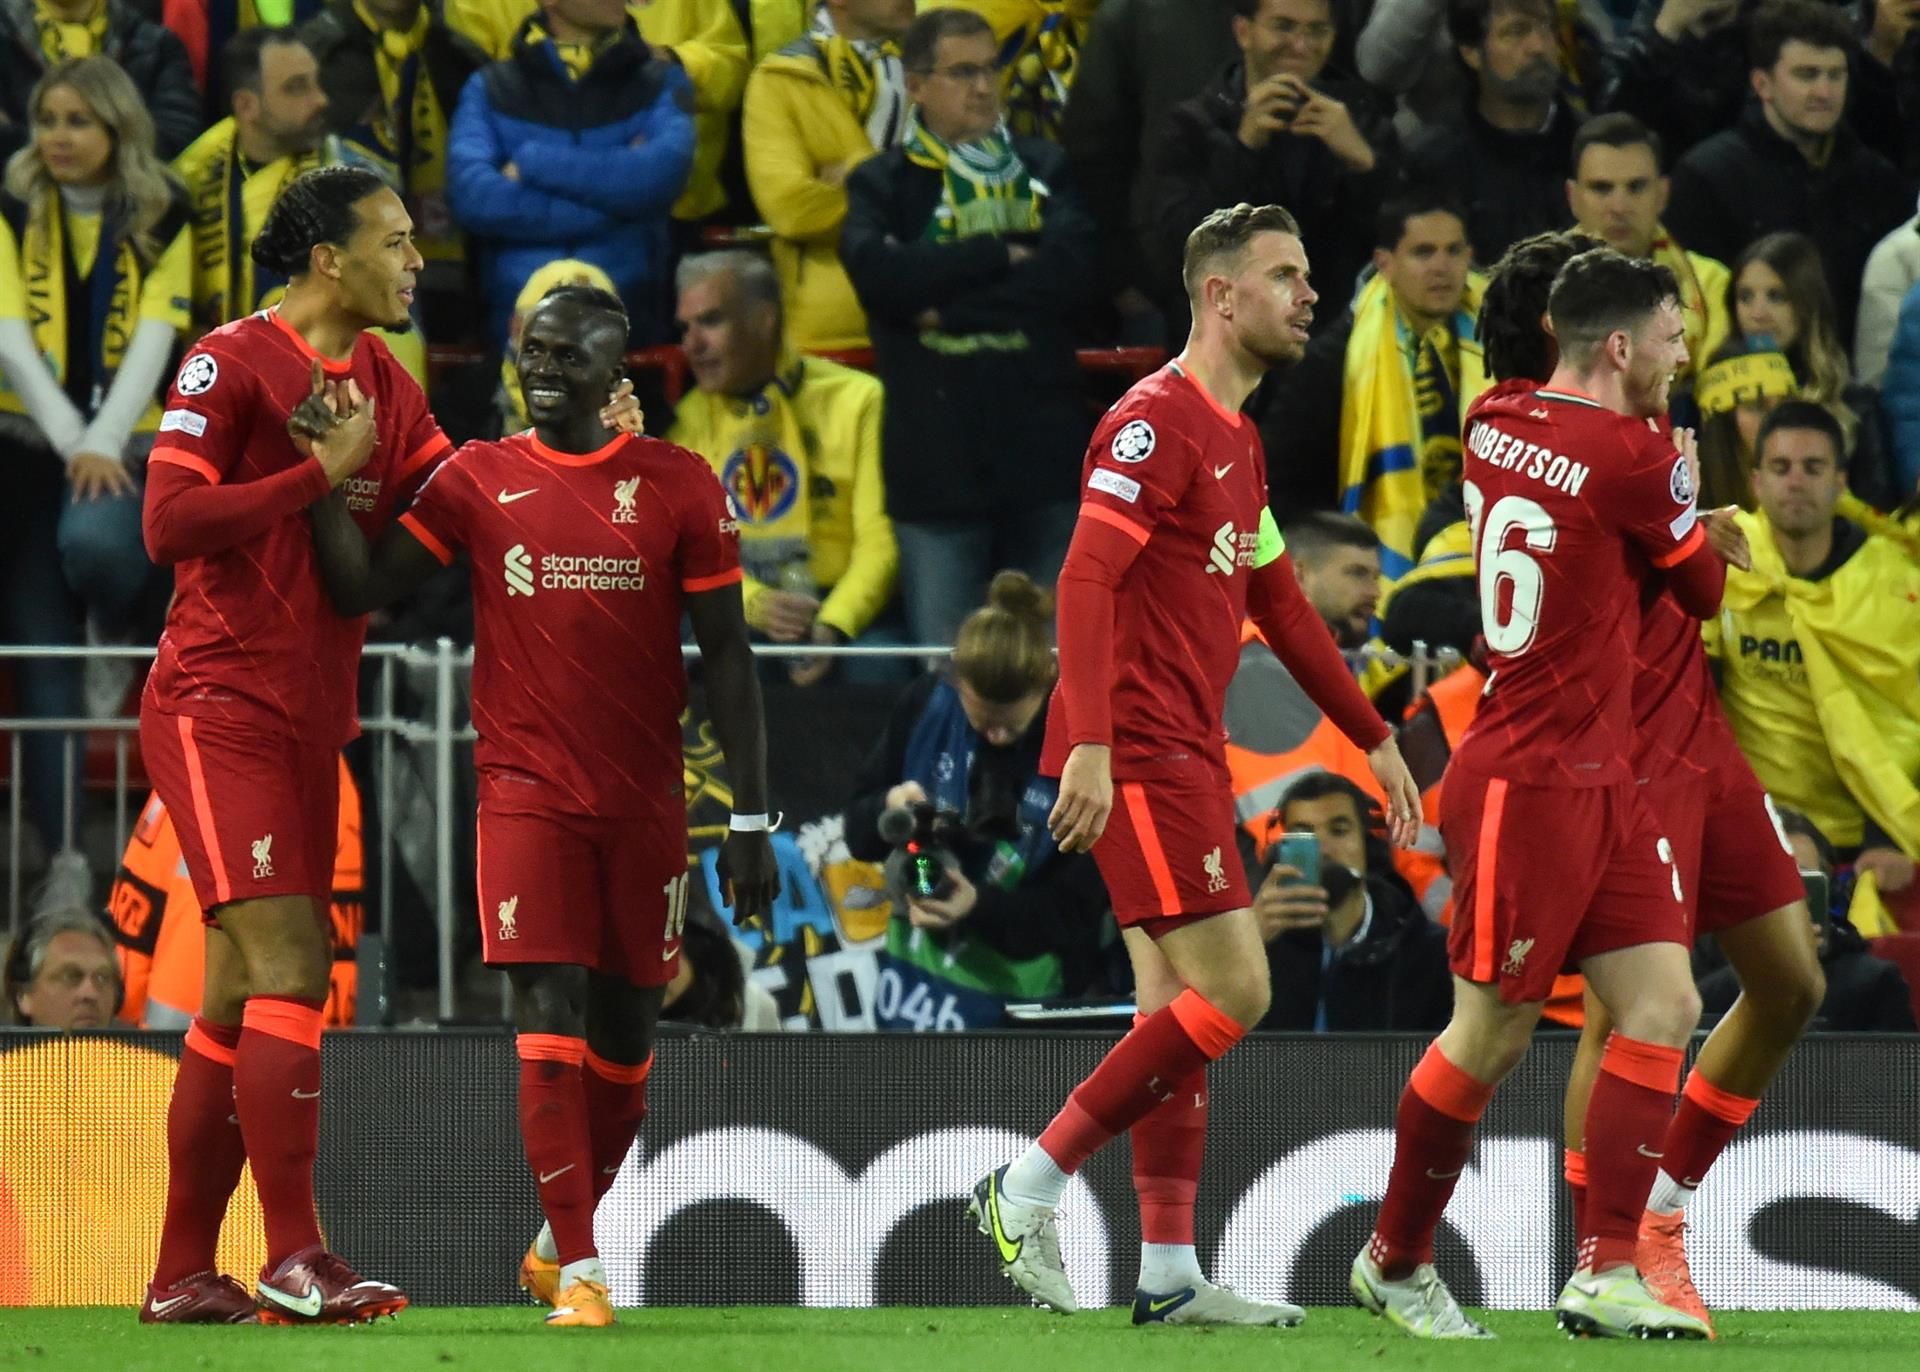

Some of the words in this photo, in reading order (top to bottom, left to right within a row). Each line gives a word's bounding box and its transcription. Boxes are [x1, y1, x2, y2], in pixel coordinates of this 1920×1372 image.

[1467, 420, 1590, 497] ROBERTSON
[343, 477, 382, 496] ndard
[719, 517, 738, 535] Exp
[541, 553, 641, 573] standard
[541, 572, 645, 591] chartered
